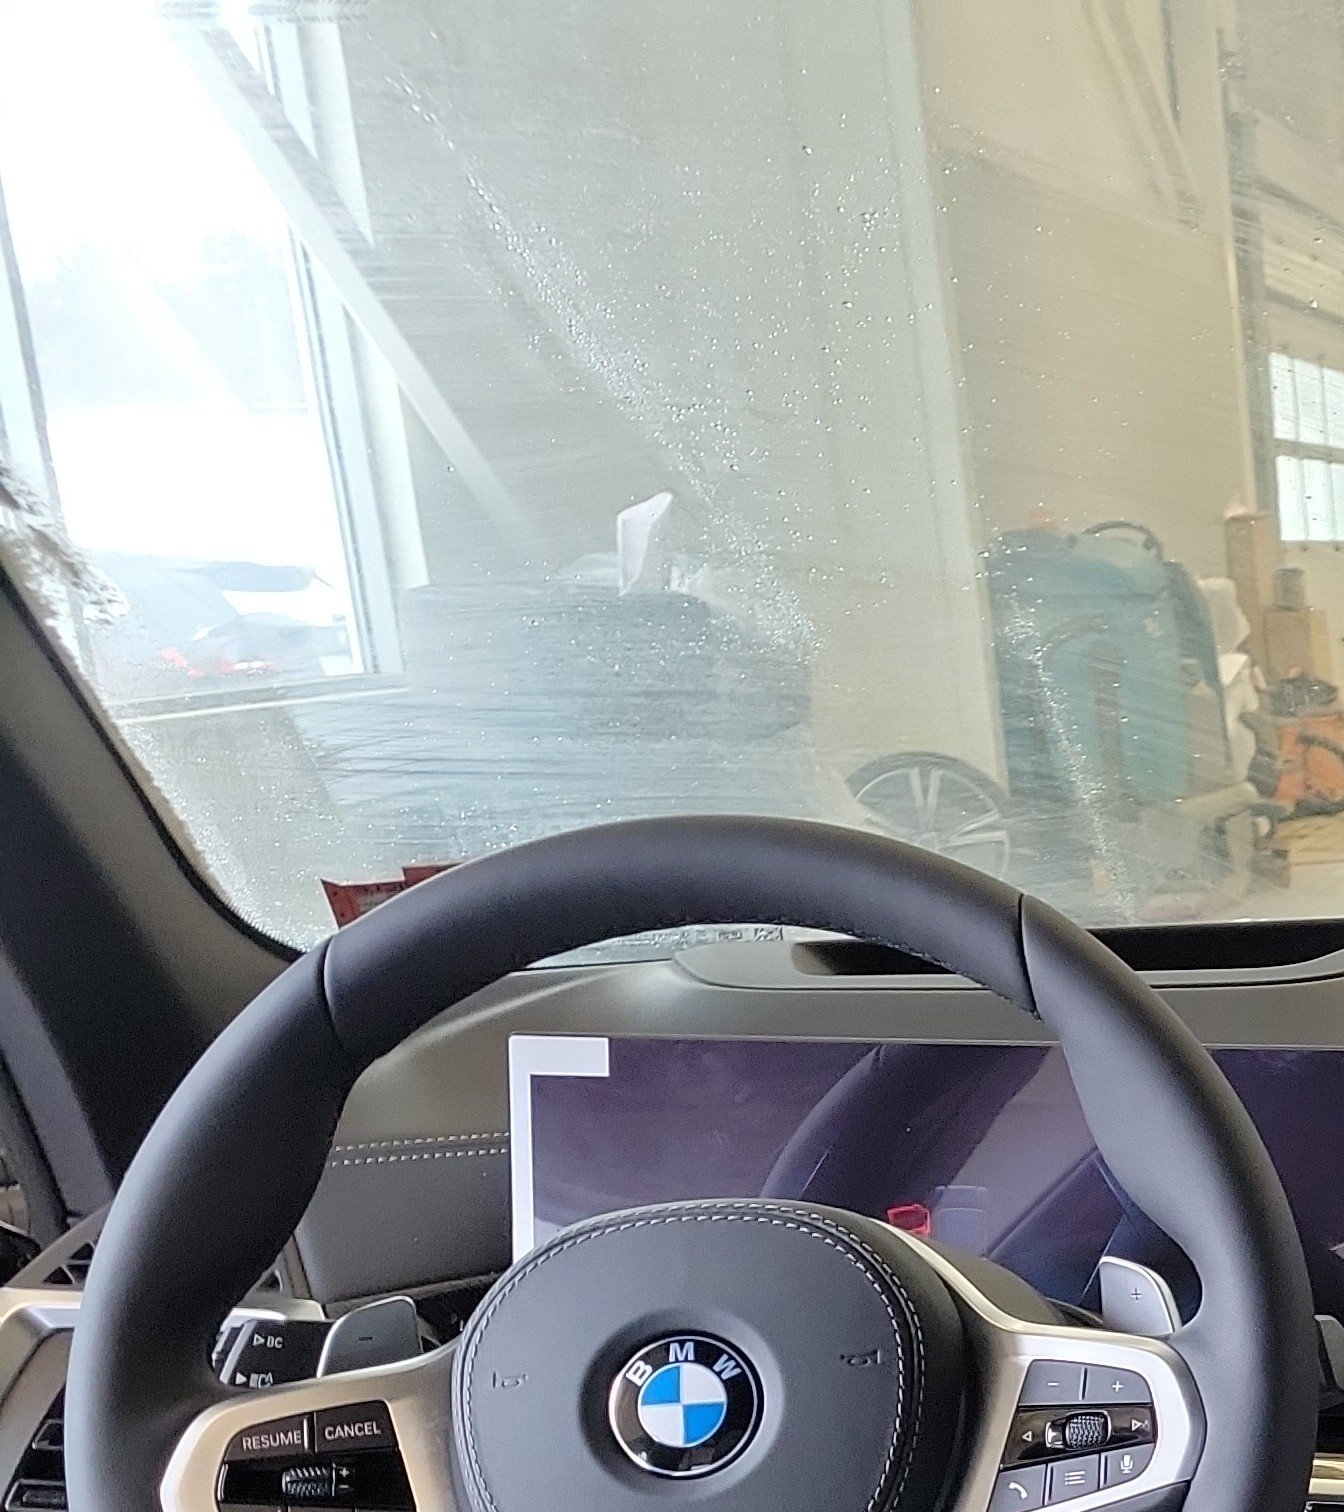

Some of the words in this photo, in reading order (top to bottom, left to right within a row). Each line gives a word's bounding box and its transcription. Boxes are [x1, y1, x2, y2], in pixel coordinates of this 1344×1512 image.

[625, 1341, 742, 1387] BMW
[242, 1429, 302, 1451] RESUME
[324, 1420, 382, 1440] CANCEL
